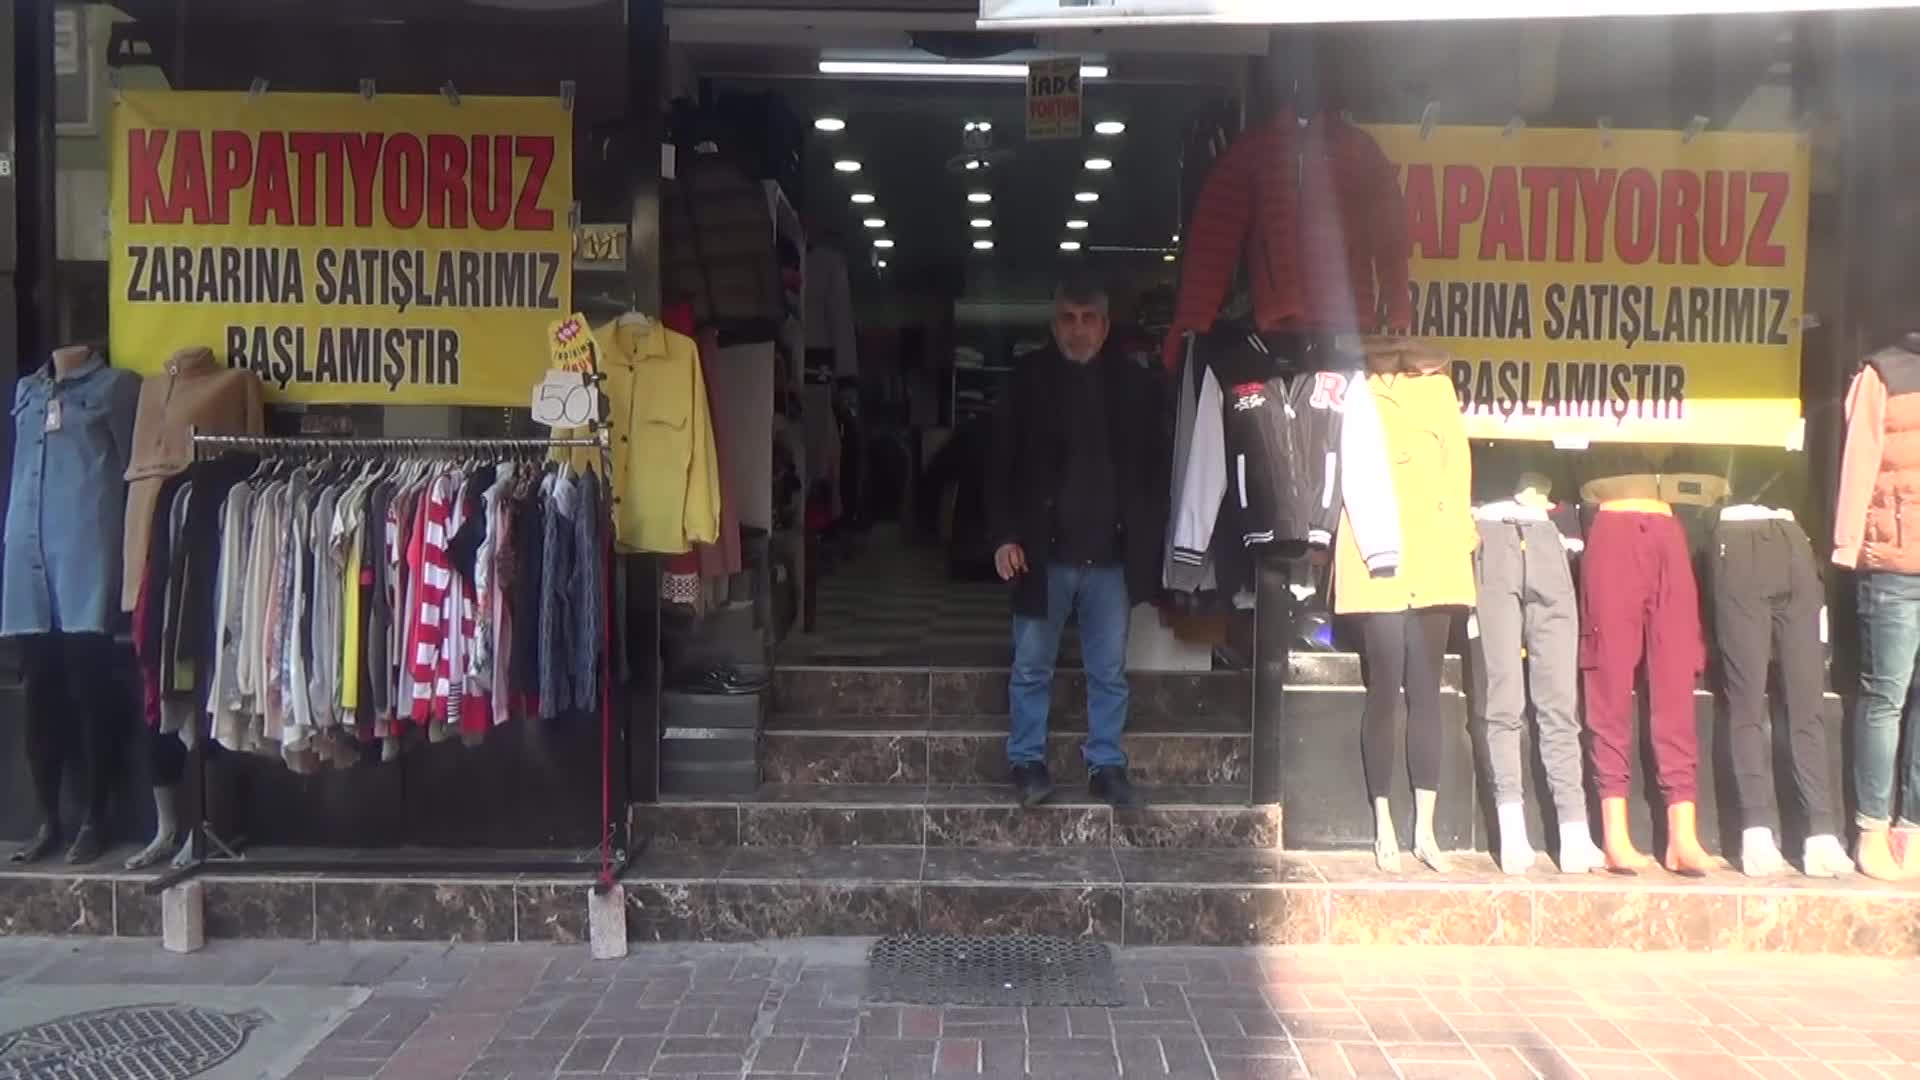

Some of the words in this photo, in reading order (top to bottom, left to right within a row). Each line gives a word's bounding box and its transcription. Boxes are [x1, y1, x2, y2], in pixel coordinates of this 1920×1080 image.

[127, 128, 555, 231] KAPATIYORUZ
[1393, 163, 1790, 267] APATIYORUZ
[127, 245, 303, 304] ZARARINA
[315, 247, 559, 313] SATIŞLARIMIZ
[1543, 284, 1790, 349] SATIŞLARIMIZ
[227, 325, 458, 391] BAŞLAMIŞTIR
[540, 384, 592, 425] 50
[1309, 371, 1347, 412] R
[1452, 360, 1685, 427] BAŞLAMIŞTIR
